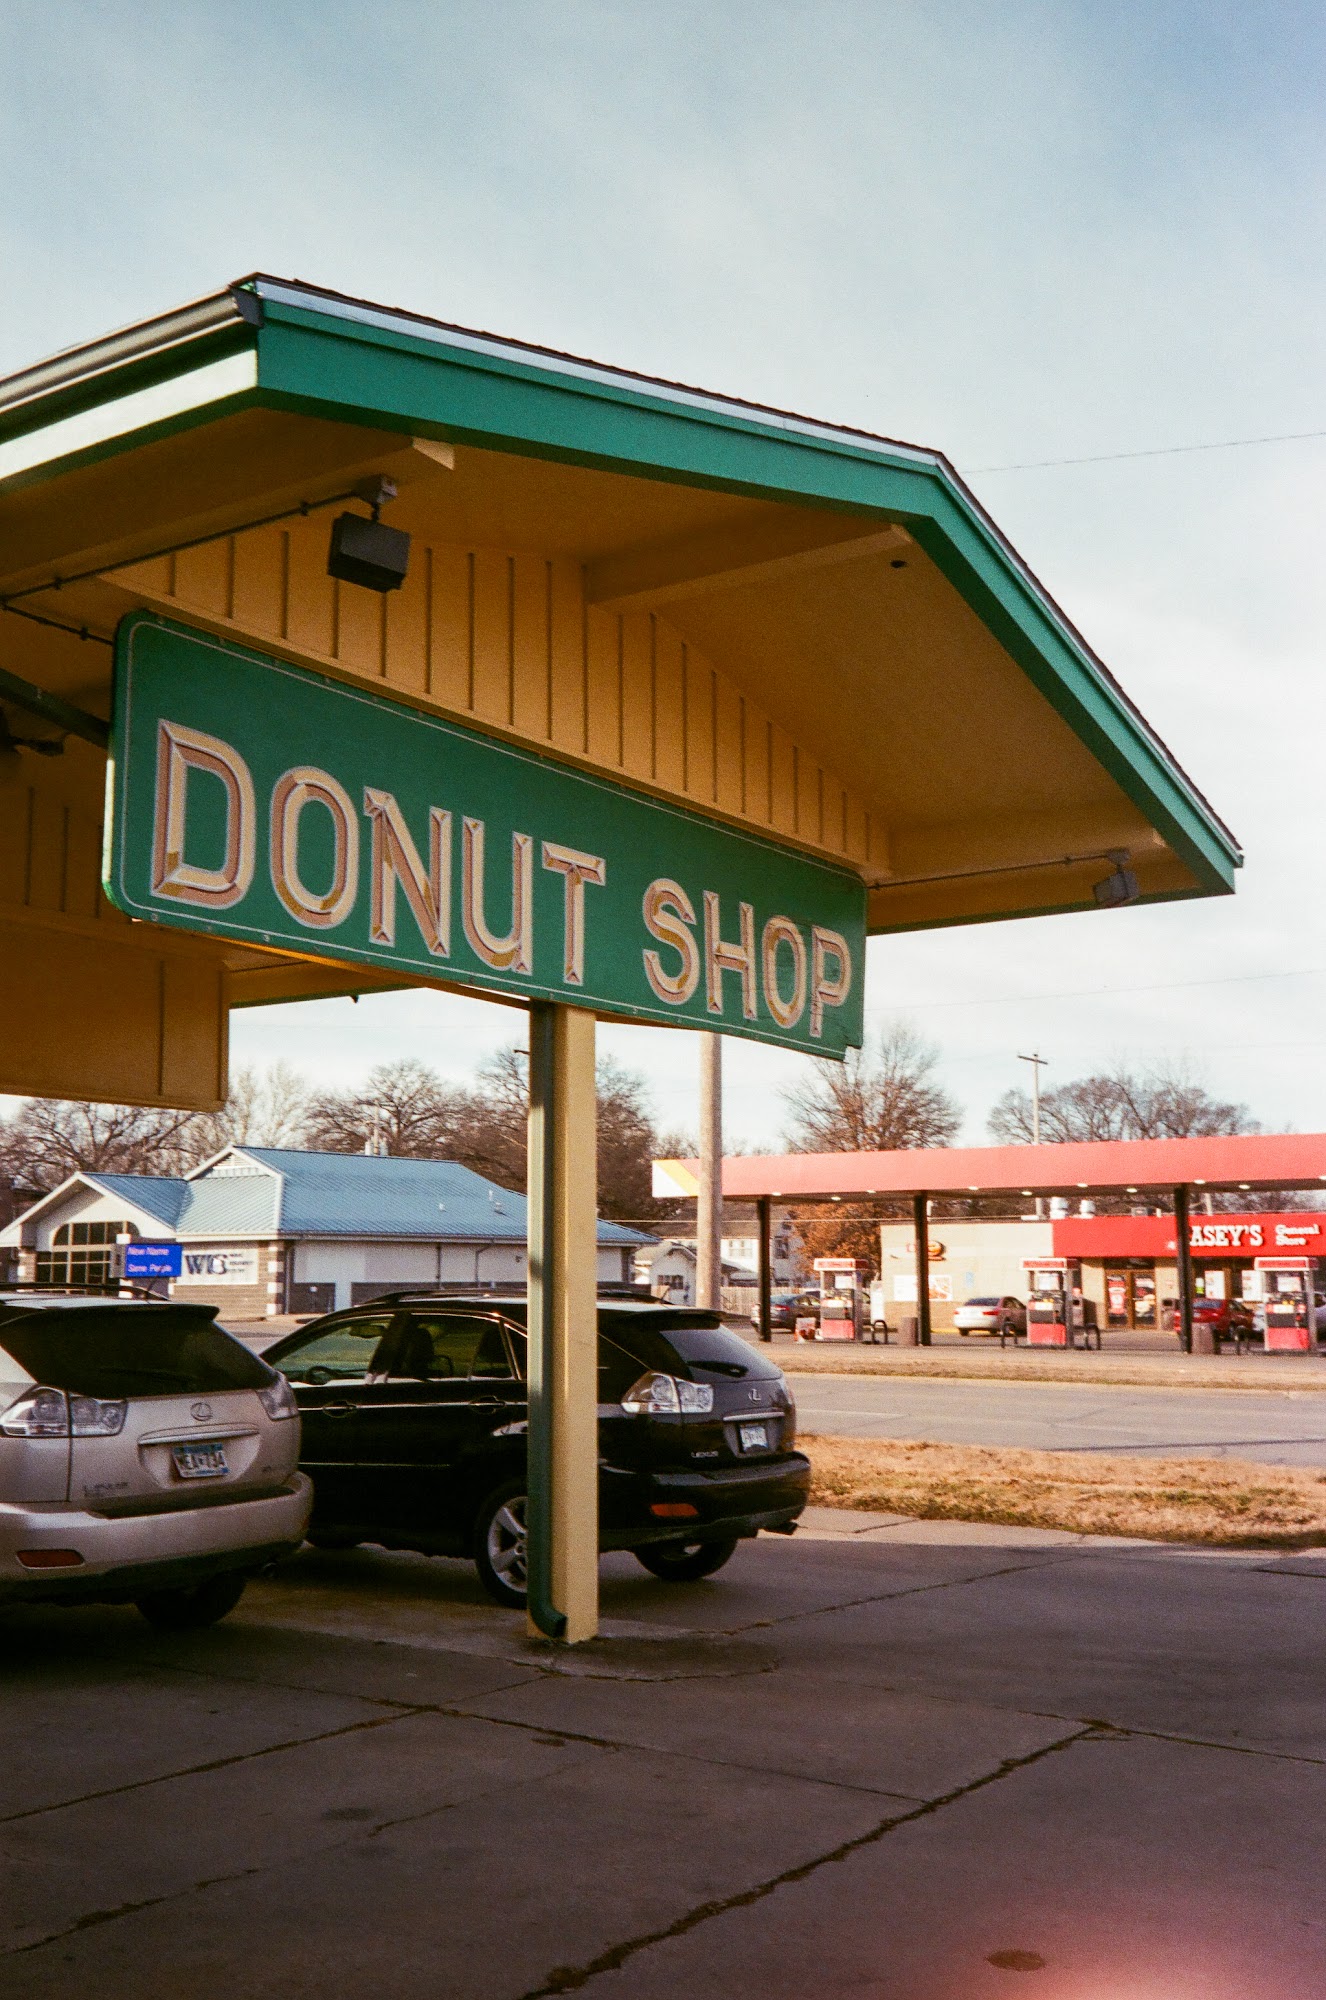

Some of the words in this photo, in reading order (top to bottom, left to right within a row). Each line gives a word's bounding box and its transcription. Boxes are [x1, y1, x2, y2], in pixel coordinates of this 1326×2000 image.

[149, 717, 607, 987] DONUT
[642, 877, 852, 1038] SHOP
[1189, 1225, 1263, 1246] ASEY'S
[128, 1246, 145, 1255] New
[146, 1246, 169, 1255] Name
